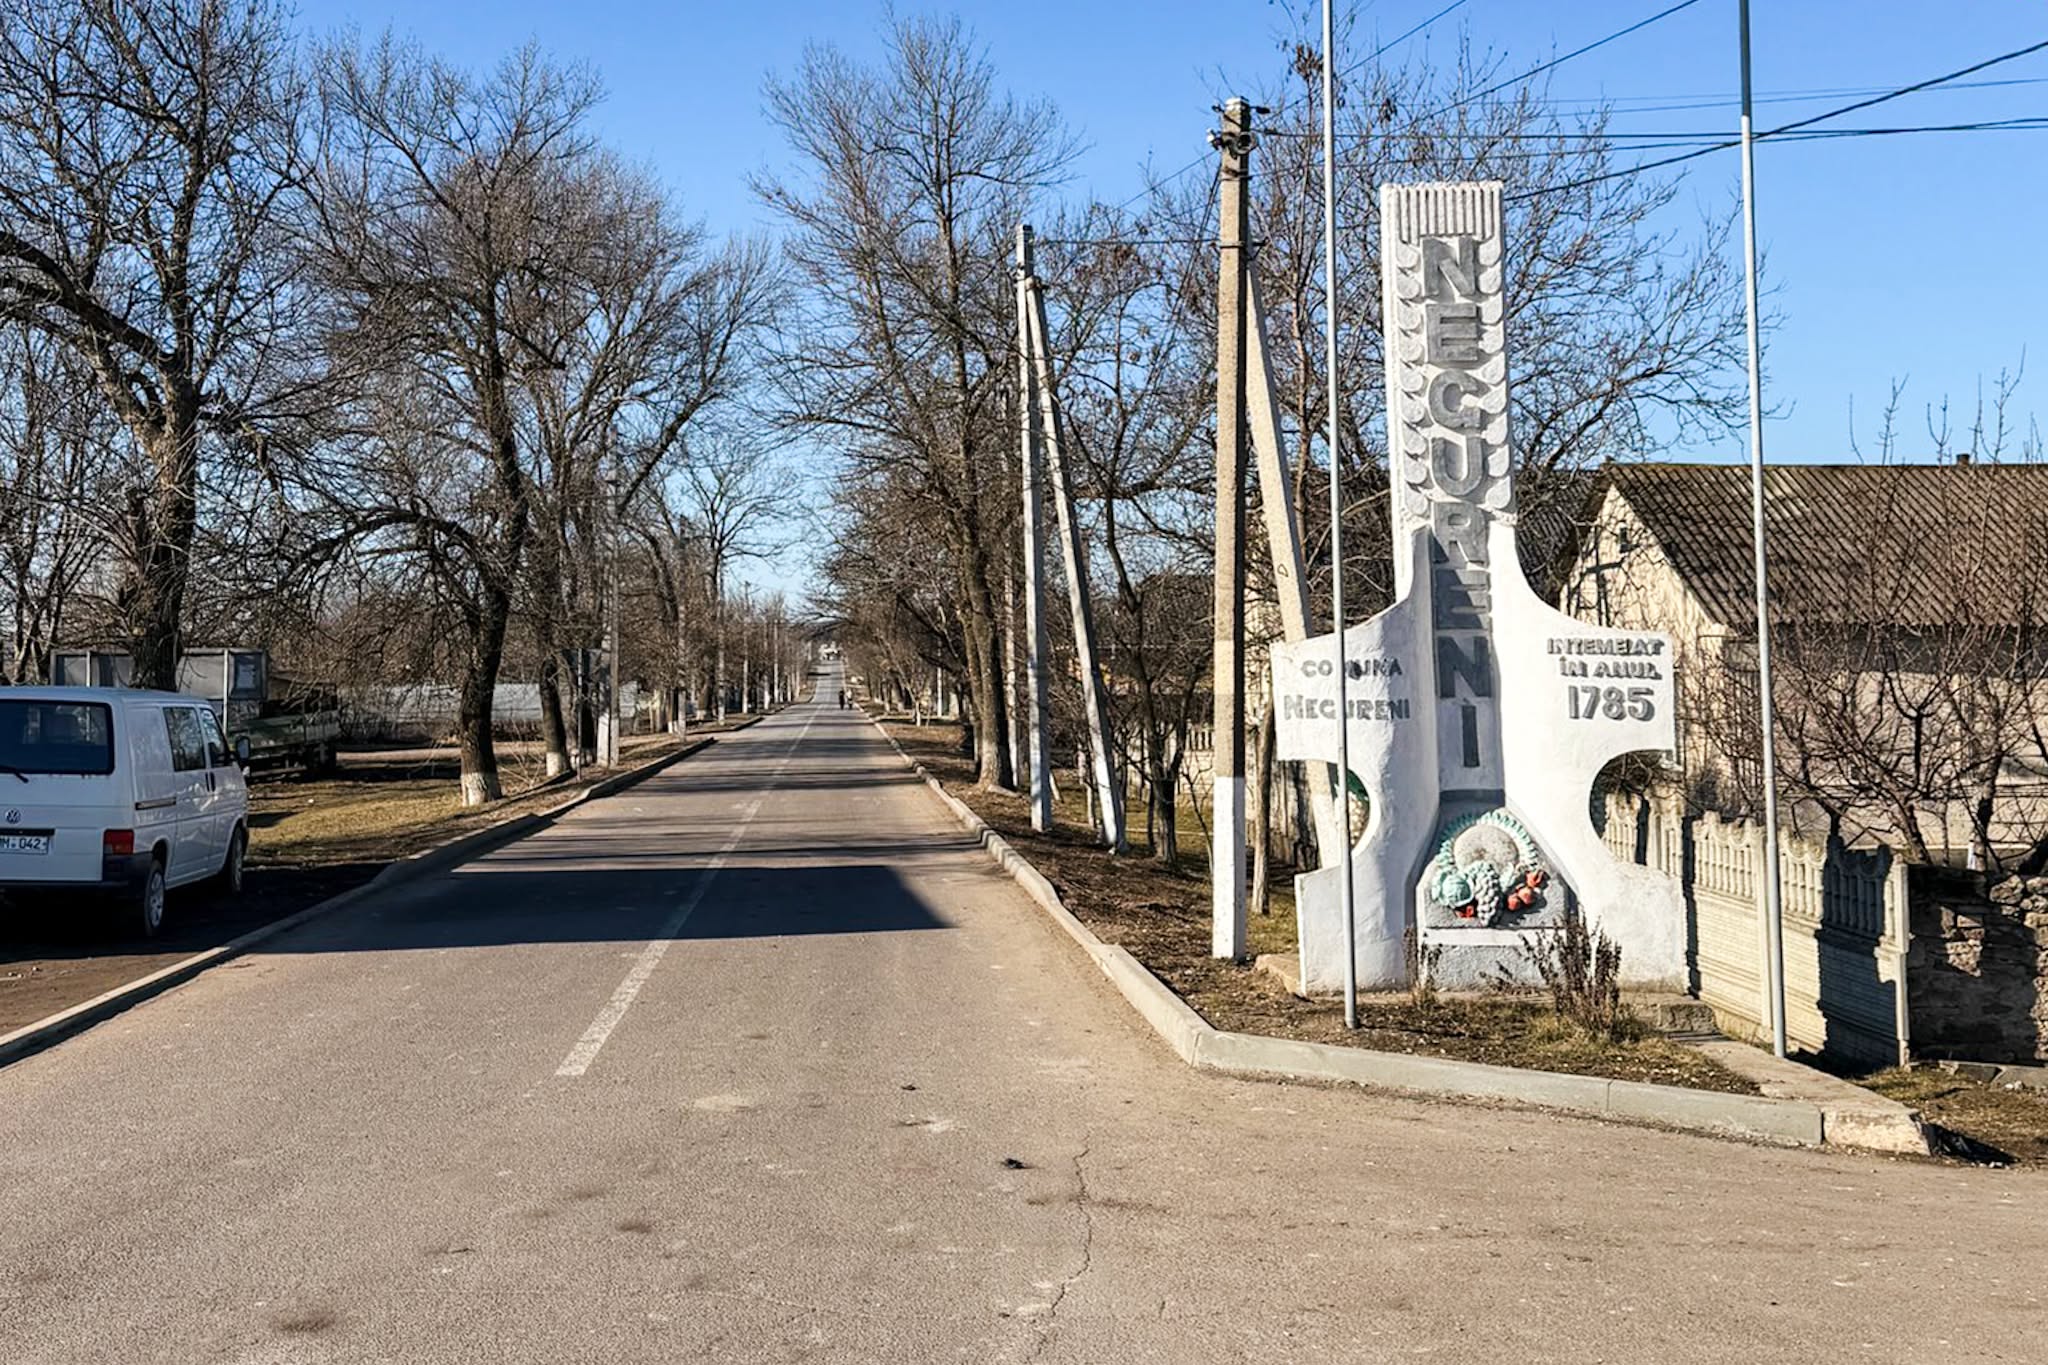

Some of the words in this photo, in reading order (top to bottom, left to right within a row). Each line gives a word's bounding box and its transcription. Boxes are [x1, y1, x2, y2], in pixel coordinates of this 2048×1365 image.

[1421, 234, 1492, 768] NEGURENI
[1593, 661, 1662, 680] ANUL
[1568, 685, 1655, 722] 1785
